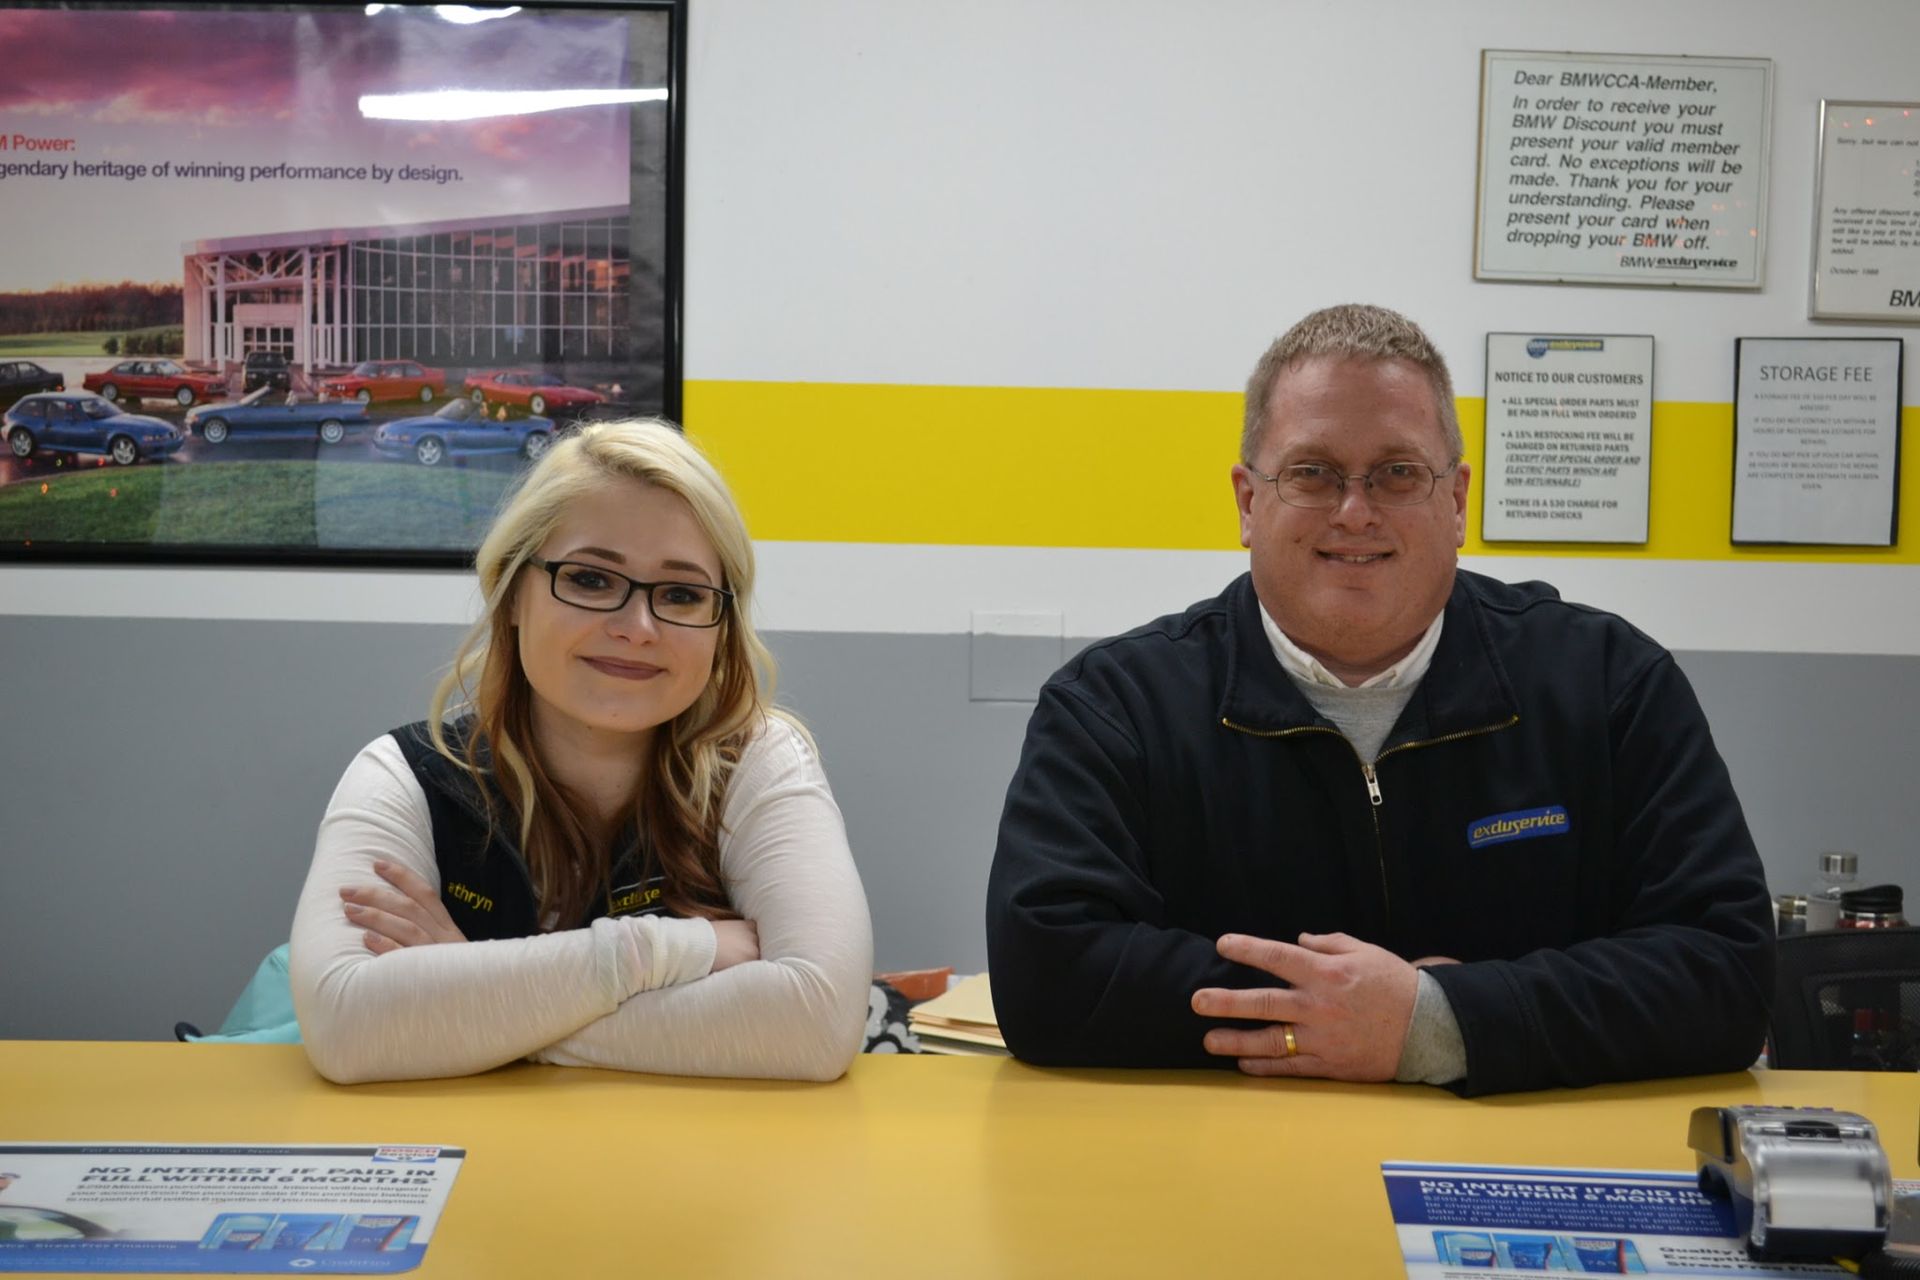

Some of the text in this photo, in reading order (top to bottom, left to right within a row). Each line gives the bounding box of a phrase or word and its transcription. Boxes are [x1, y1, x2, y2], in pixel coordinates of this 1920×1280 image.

[1514, 70, 1718, 93] Dear BMWCCA-Member,
[1512, 95, 1716, 118] In order to receive your
[1512, 114, 1723, 136] BMW Discount you must
[13, 134, 76, 151] Power:
[1510, 134, 1740, 155] present your valid member
[1510, 153, 1742, 174] card. No exceptions will be
[73, 160, 147, 180] heritage
[152, 161, 171, 177] of
[174, 161, 245, 181] winning
[250, 163, 367, 181] performance
[372, 164, 394, 184] by
[398, 164, 463, 184] design.
[1509, 173, 1733, 195] made. Thank you for your
[1508, 192, 1695, 211] understanding. Please
[1507, 212, 1709, 230] present your card when
[1507, 229, 1710, 250] dropping your BMW off.
[1495, 371, 1643, 385] NOTICE TO OUR CUSTOMERS
[1760, 366, 1873, 382] STORAGE FEE
[1507, 397, 1640, 408] ALL SPECIAL ORDER PARTS MUST
[1507, 409, 1637, 420] BE PAID IN FULL WHEN ORDERED
[1507, 431, 1513, 439] A
[1534, 431, 1585, 441] RESTOCKING
[1586, 432, 1600, 441] FEE
[1602, 432, 1622, 441] WILL
[1624, 433, 1634, 441] BE
[1505, 442, 1629, 453] CHARGED ON RETURNED PARTS
[1505, 499, 1530, 508] THERE
[1532, 500, 1540, 508] IS
[1541, 500, 1548, 508] A
[1567, 500, 1600, 509] CHARGE
[1602, 501, 1618, 509] FOR
[1506, 510, 1583, 520] RETURNED CHECKS
[88, 1166, 435, 1176] NO INTEREST IF PAID IN
[162, 1175, 270, 1183] WITHIN
[276, 1175, 294, 1183] 6
[1419, 1180, 1703, 1198] NO INTEREST IF PAID IN
[1420, 1187, 1480, 1196] FULL
[1484, 1190, 1577, 1200] WITHIN
[1582, 1193, 1599, 1201] 6
[1658, 1246, 1731, 1256] Quality
